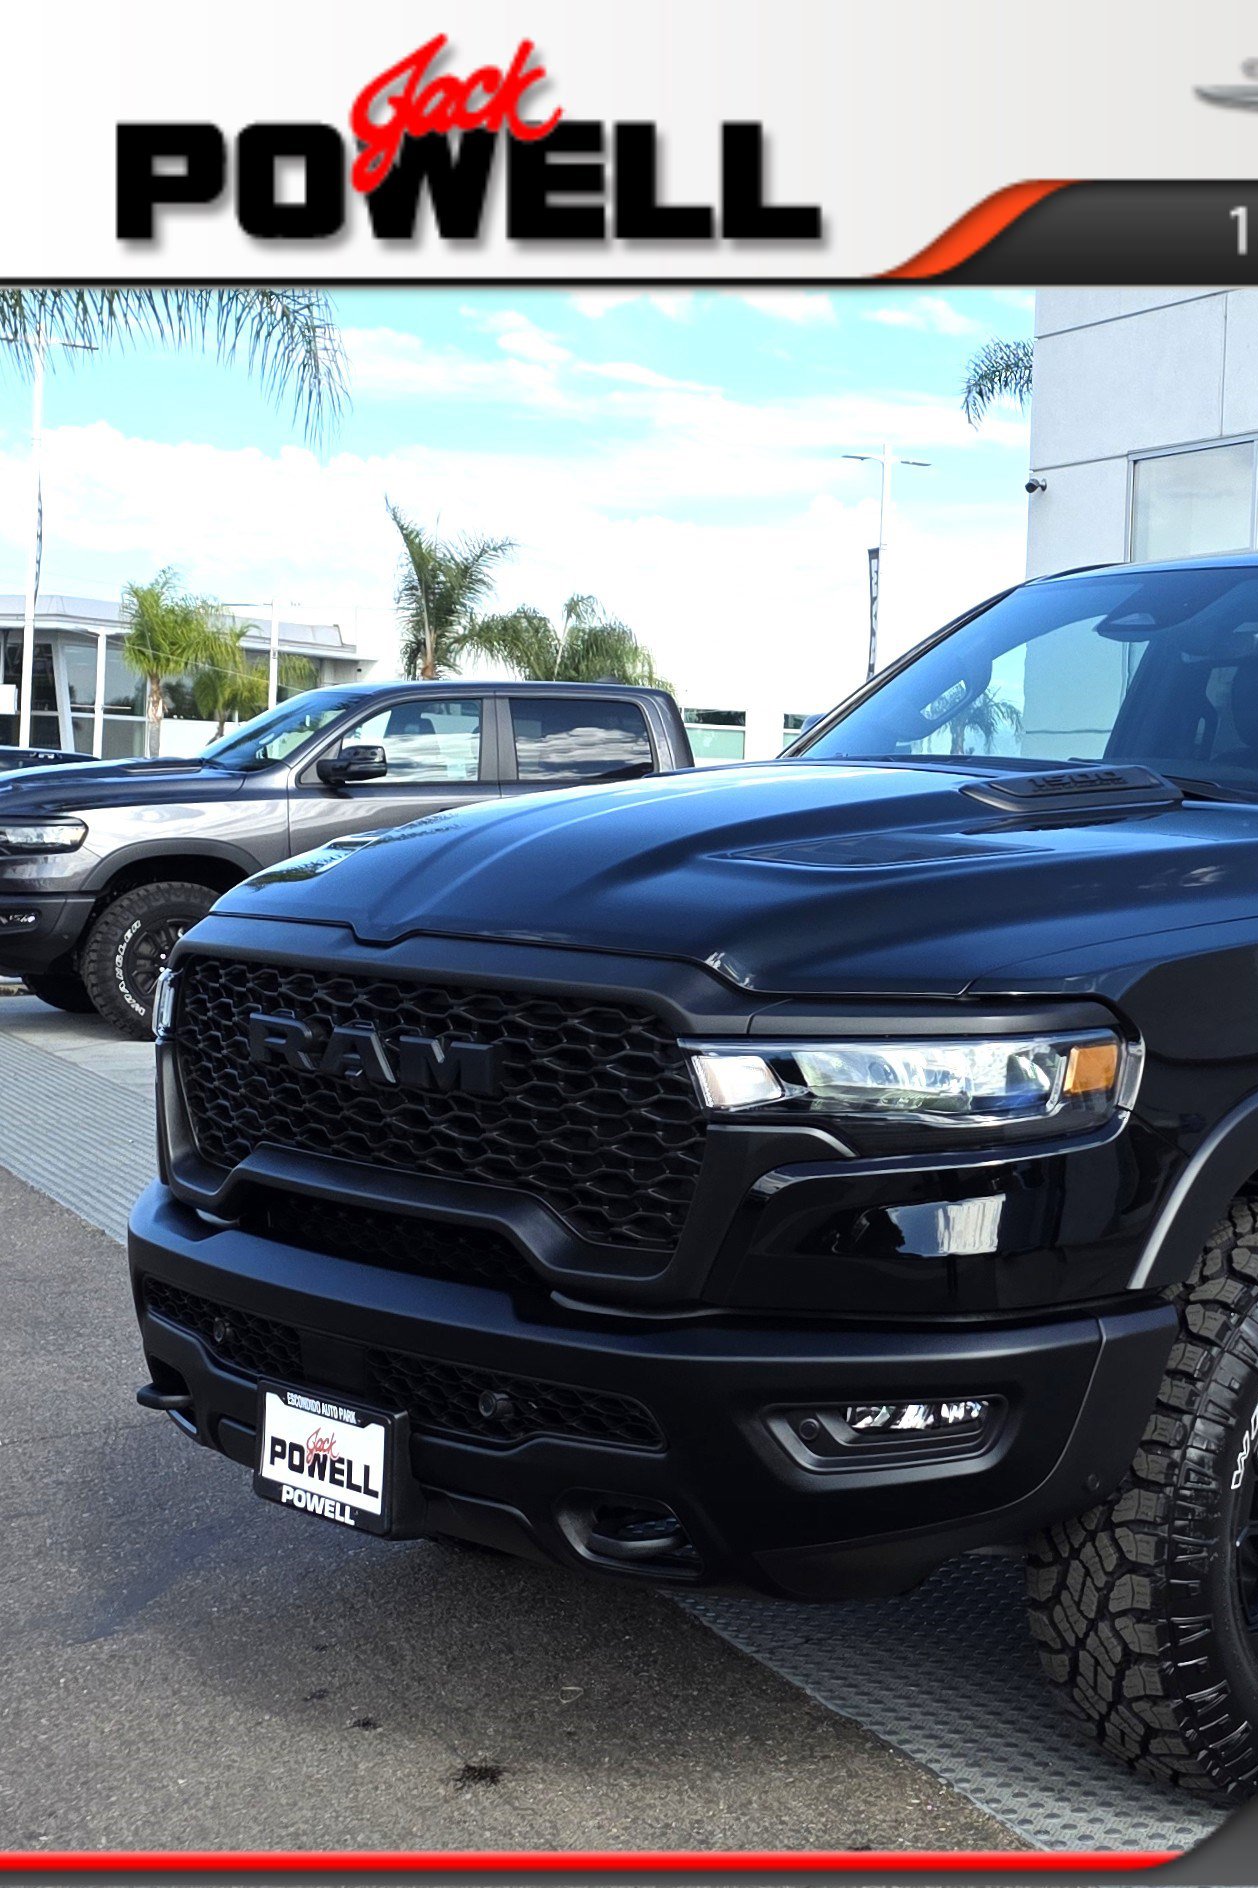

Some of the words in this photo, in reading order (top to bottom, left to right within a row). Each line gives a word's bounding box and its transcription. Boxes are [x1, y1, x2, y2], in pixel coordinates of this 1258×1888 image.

[250, 1012, 499, 1096] RAM
[321, 1402, 339, 1420] AUTO
[338, 1406, 357, 1425] PARK
[269, 1435, 380, 1500] POWELL
[306, 1427, 340, 1465] Jack
[281, 1484, 356, 1527] POWELL
